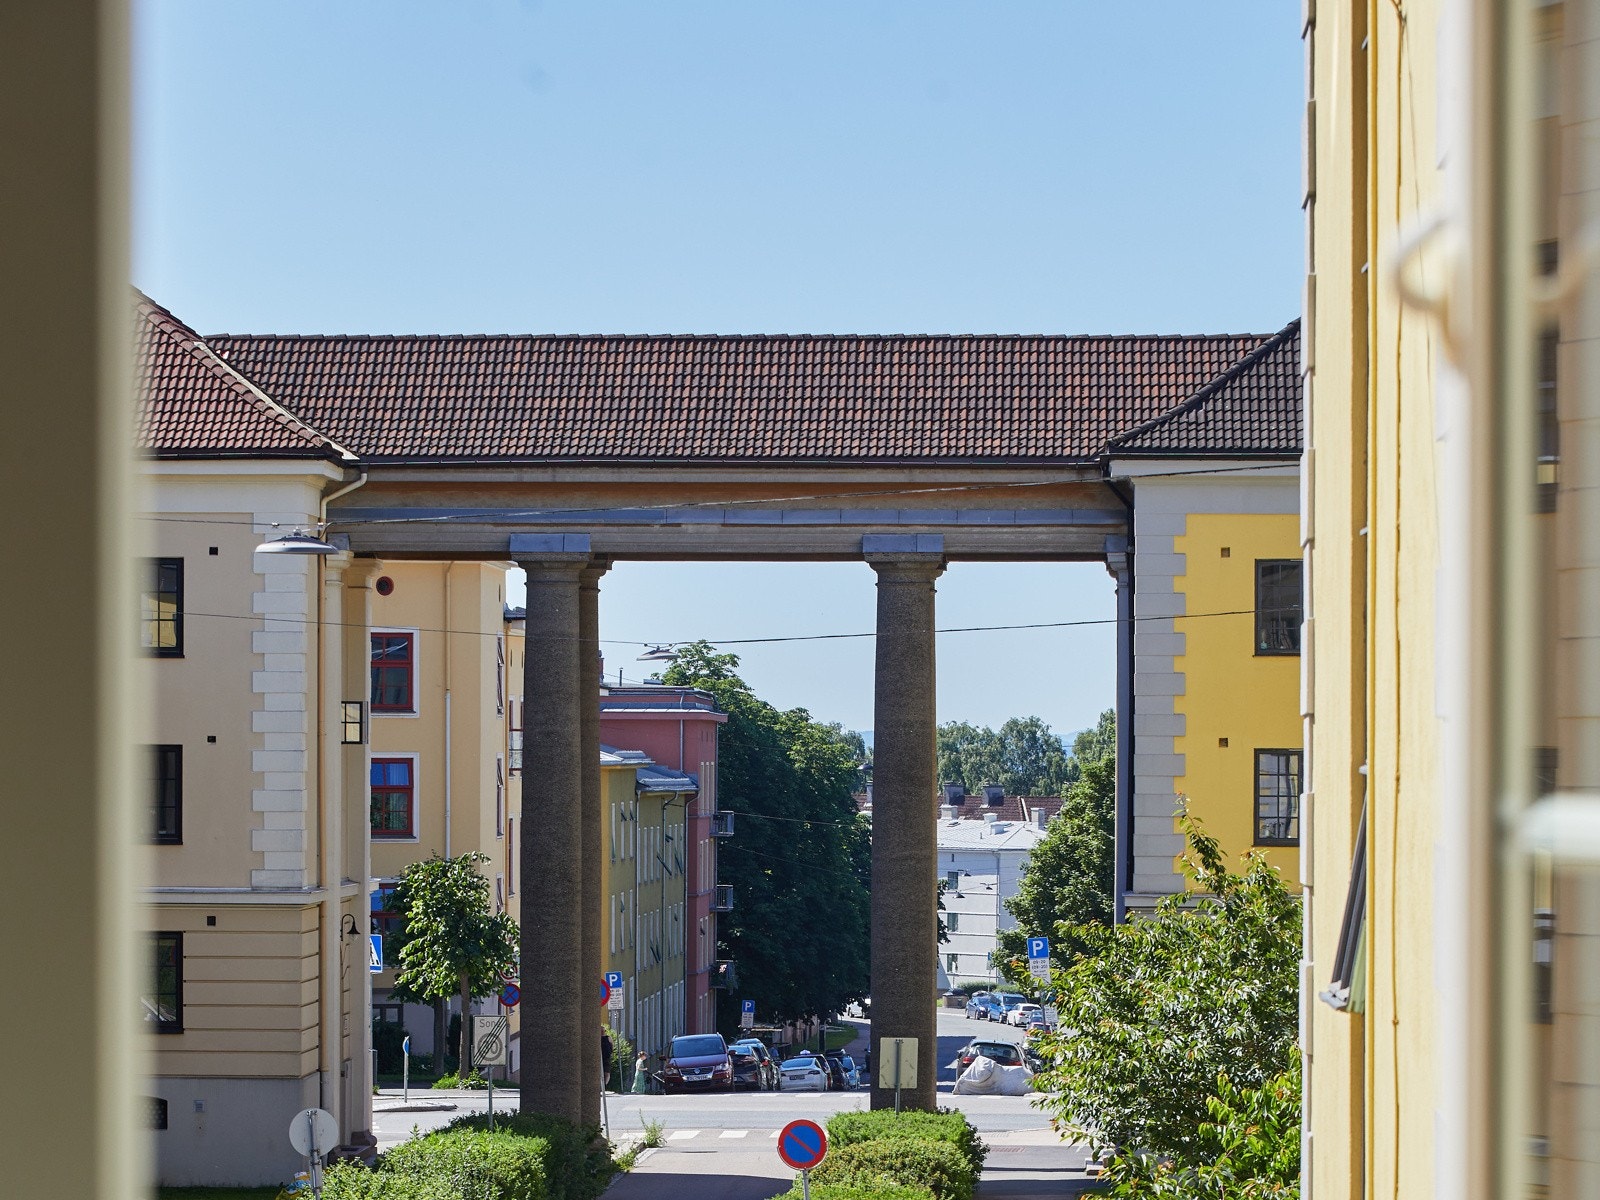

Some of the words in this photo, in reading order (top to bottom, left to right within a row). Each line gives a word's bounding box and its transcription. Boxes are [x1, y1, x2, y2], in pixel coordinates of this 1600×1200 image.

[1032, 940, 1044, 957] P
[609, 974, 618, 987] P
[745, 1001, 752, 1011] P
[479, 1018, 499, 1028] Son
